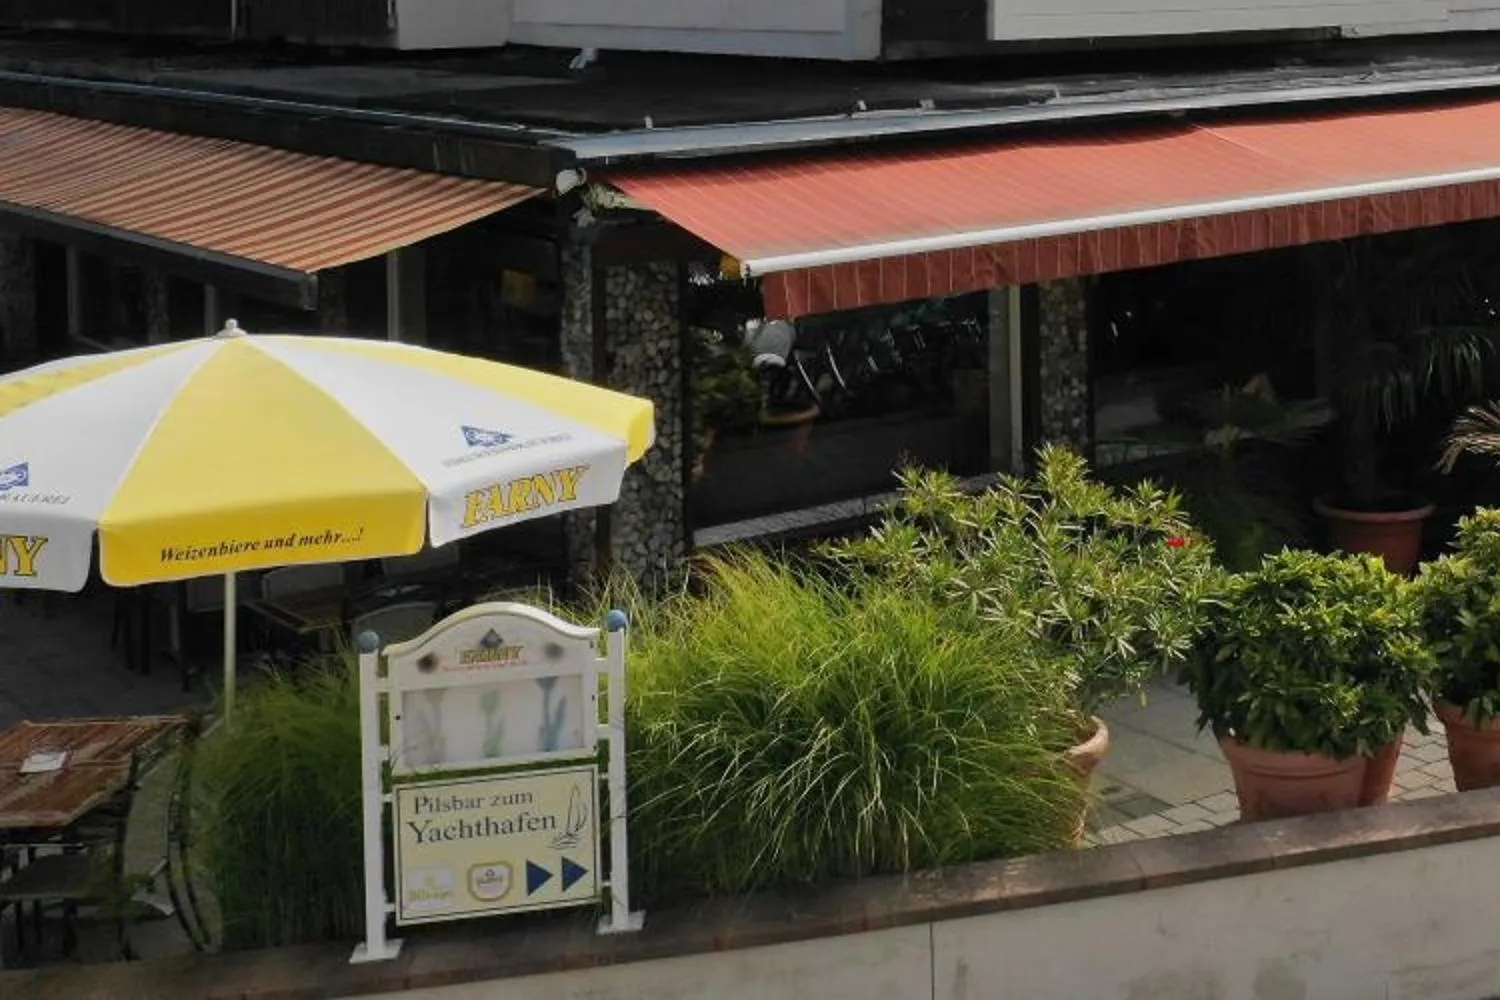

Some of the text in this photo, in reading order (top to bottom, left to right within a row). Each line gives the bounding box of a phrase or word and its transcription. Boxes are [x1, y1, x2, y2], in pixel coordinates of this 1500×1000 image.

[461, 463, 592, 529] FARNY
[160, 542, 263, 563] Weizenbiere
[263, 533, 297, 550] und
[414, 791, 534, 815] Pilsbar zum
[405, 811, 557, 844] Yachthafen
